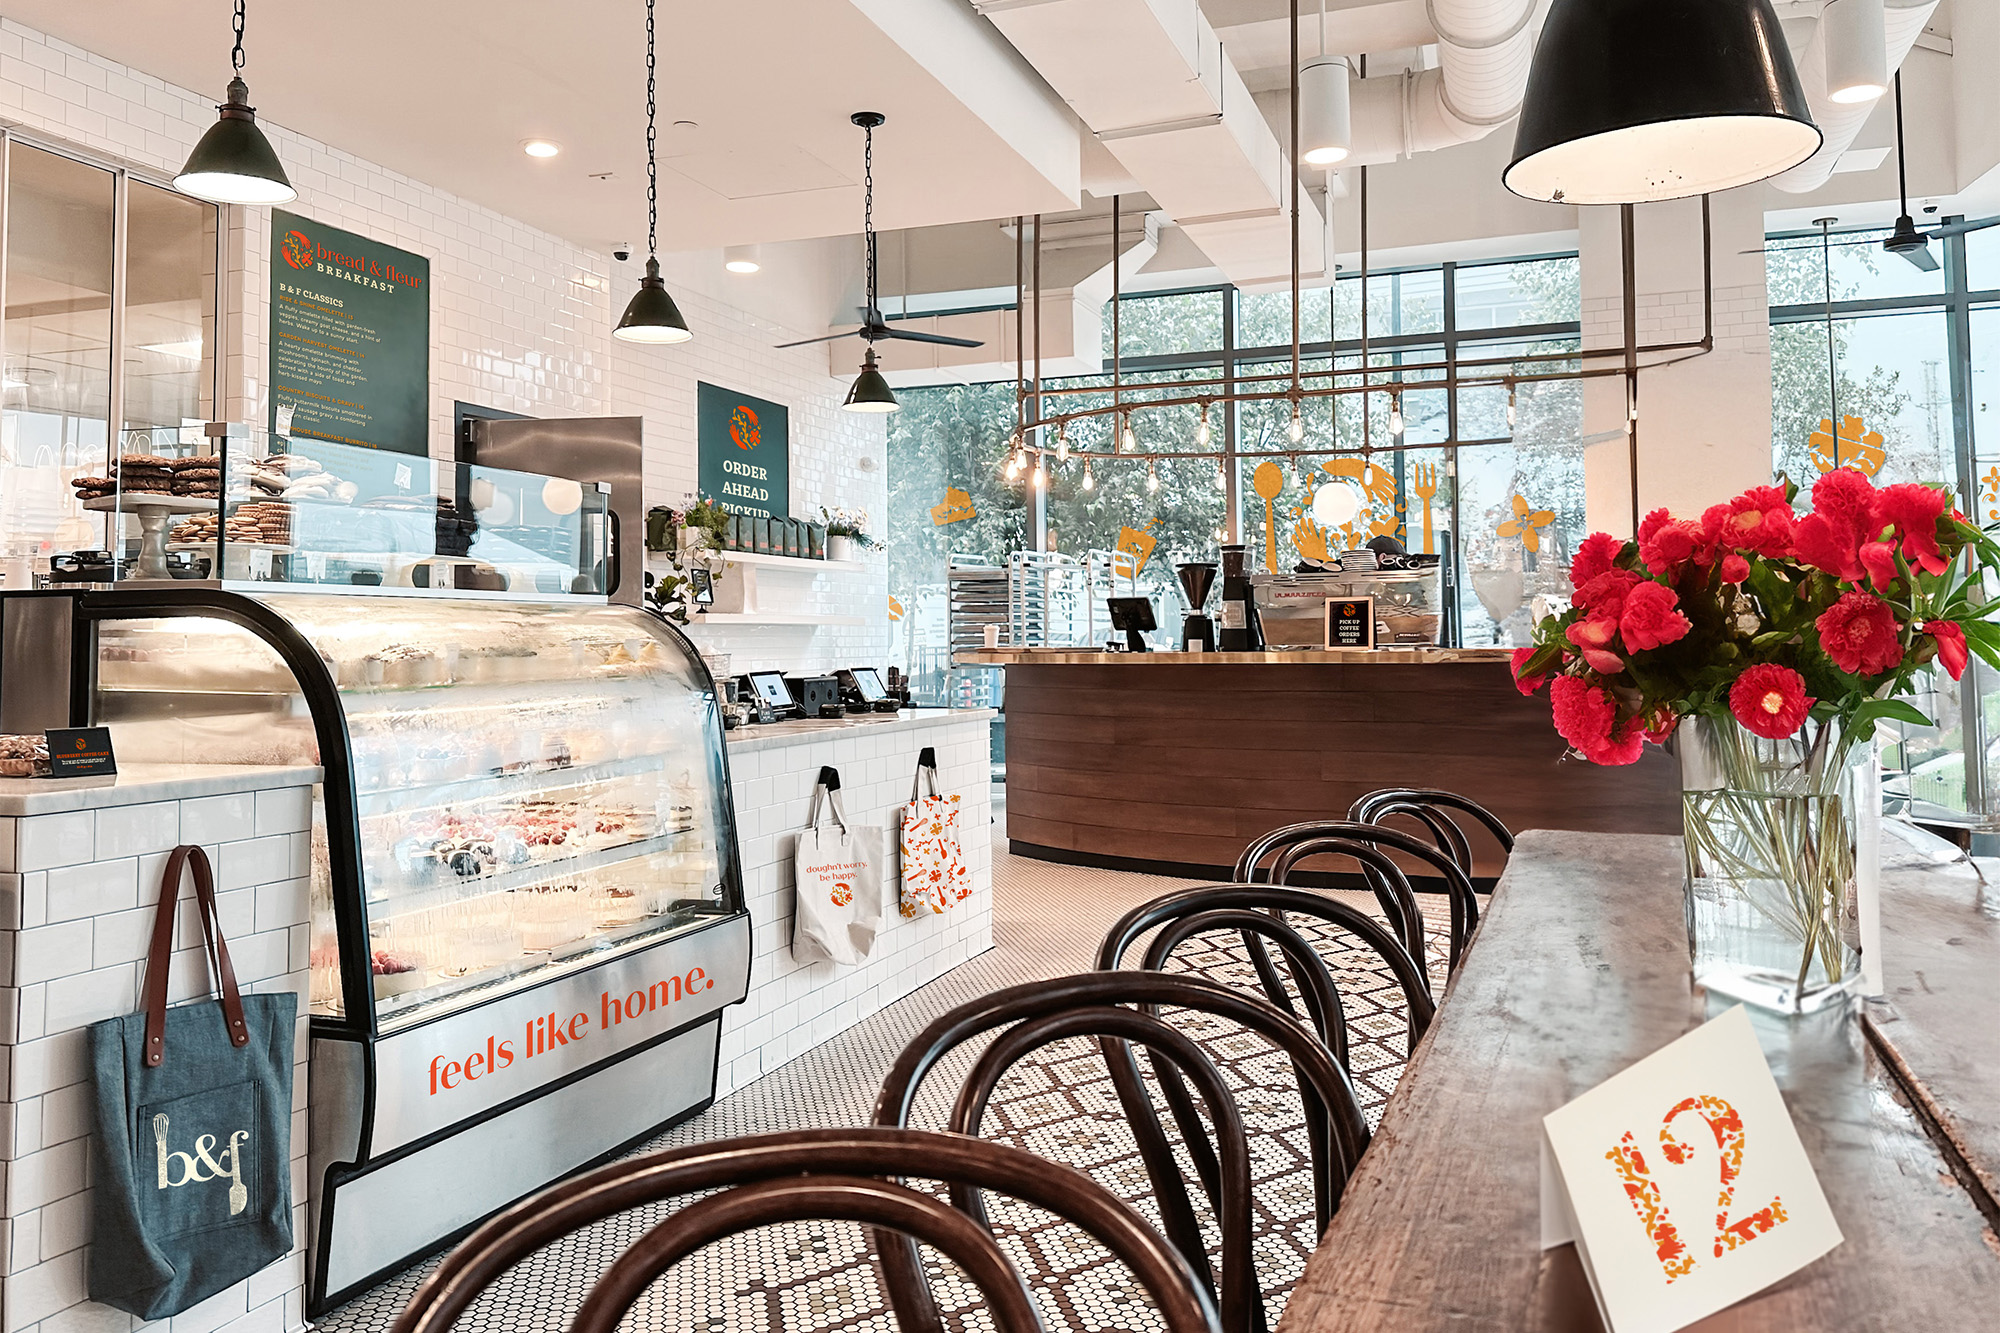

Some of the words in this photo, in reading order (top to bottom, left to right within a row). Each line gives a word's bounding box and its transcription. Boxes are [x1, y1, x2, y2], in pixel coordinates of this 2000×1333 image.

[317, 242, 365, 272] bread
[370, 260, 382, 277] &
[386, 265, 422, 288] fleur
[316, 262, 395, 294] BREAKFAST
[279, 282, 286, 292] B
[288, 285, 295, 294] &
[296, 287, 301, 296] F
[303, 289, 344, 308] CLASSICS
[299, 310, 321, 319] omelette
[300, 301, 316, 310] SHINE
[317, 306, 344, 318] OMELETTE
[301, 317, 318, 326] creamy
[279, 332, 301, 342] GARDEN
[303, 338, 327, 348] HARVEST
[328, 345, 356, 357] OMELETTE
[284, 342, 300, 351] hearty
[302, 347, 323, 356] omelette
[324, 352, 348, 363] brimming
[278, 356, 306, 367] celebrating
[278, 363, 296, 371] Served
[278, 385, 304, 396] COUNTRY
[306, 391, 330, 402] BISCUITS
[338, 399, 355, 407] GRAVY
[298, 407, 318, 416] sausage
[321, 404, 340, 413] biscuits
[341, 408, 367, 419] smothered
[313, 431, 344, 442] BREAKFAST
[345, 438, 368, 447] BURRITO
[723, 460, 767, 480] ORDER
[722, 481, 768, 501] AHEAD
[806, 862, 842, 873] doughn't
[428, 1035, 514, 1096] feels
[526, 1011, 589, 1060] like
[601, 967, 714, 1031] home.
[152, 1112, 250, 1216] b&f
[1604, 1094, 1788, 1284] 12
